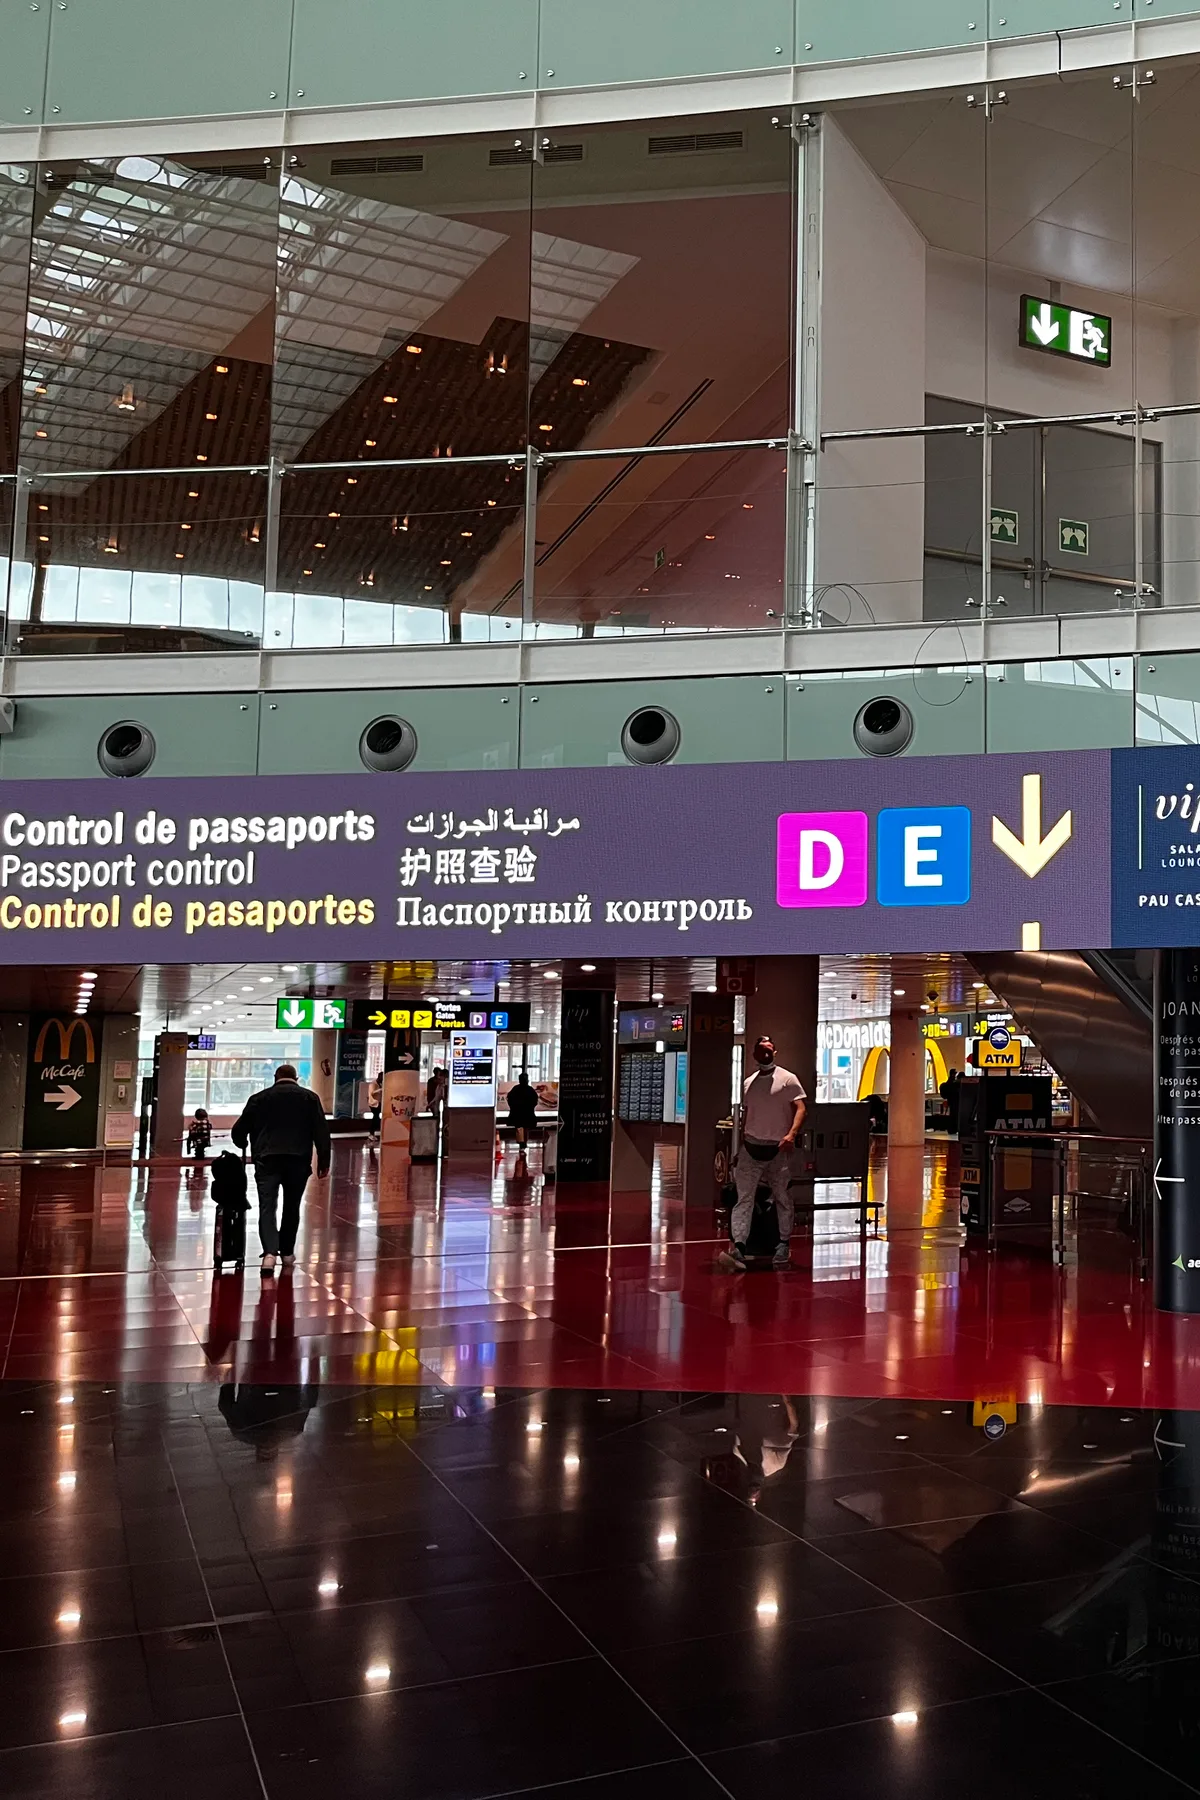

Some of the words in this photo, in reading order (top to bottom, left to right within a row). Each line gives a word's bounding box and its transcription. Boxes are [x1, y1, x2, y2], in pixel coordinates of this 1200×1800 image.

[406, 808, 499, 839] الجوازات
[502, 808, 580, 837] مراقبة
[3, 811, 124, 847] Control
[135, 810, 177, 845] de
[188, 809, 375, 851] passaports
[798, 829, 845, 890] D
[904, 825, 943, 888] E
[1, 853, 137, 892] Passport
[147, 850, 255, 887] control
[400, 844, 537, 886] 护照查验
[1139, 894, 1169, 907] PAU
[0, 894, 121, 929] Control
[132, 893, 173, 928] de
[185, 893, 375, 934] pasaportes
[396, 894, 592, 934] Паспортный
[605, 897, 753, 930] контроль
[435, 1002, 461, 1012] Portes
[435, 1019, 465, 1028] Puertas
[472, 1014, 483, 1026] D
[495, 1015, 503, 1026] E
[1160, 1034, 1194, 1046] Després
[1170, 1047, 1180, 1056] de
[985, 1054, 1014, 1064] ATM
[41, 1064, 85, 1080] McCafé
[1160, 1076, 1197, 1087] Después
[1169, 1088, 1180, 1097] de
[994, 1118, 1047, 1139] ATM
[963, 1170, 978, 1182] ATM
